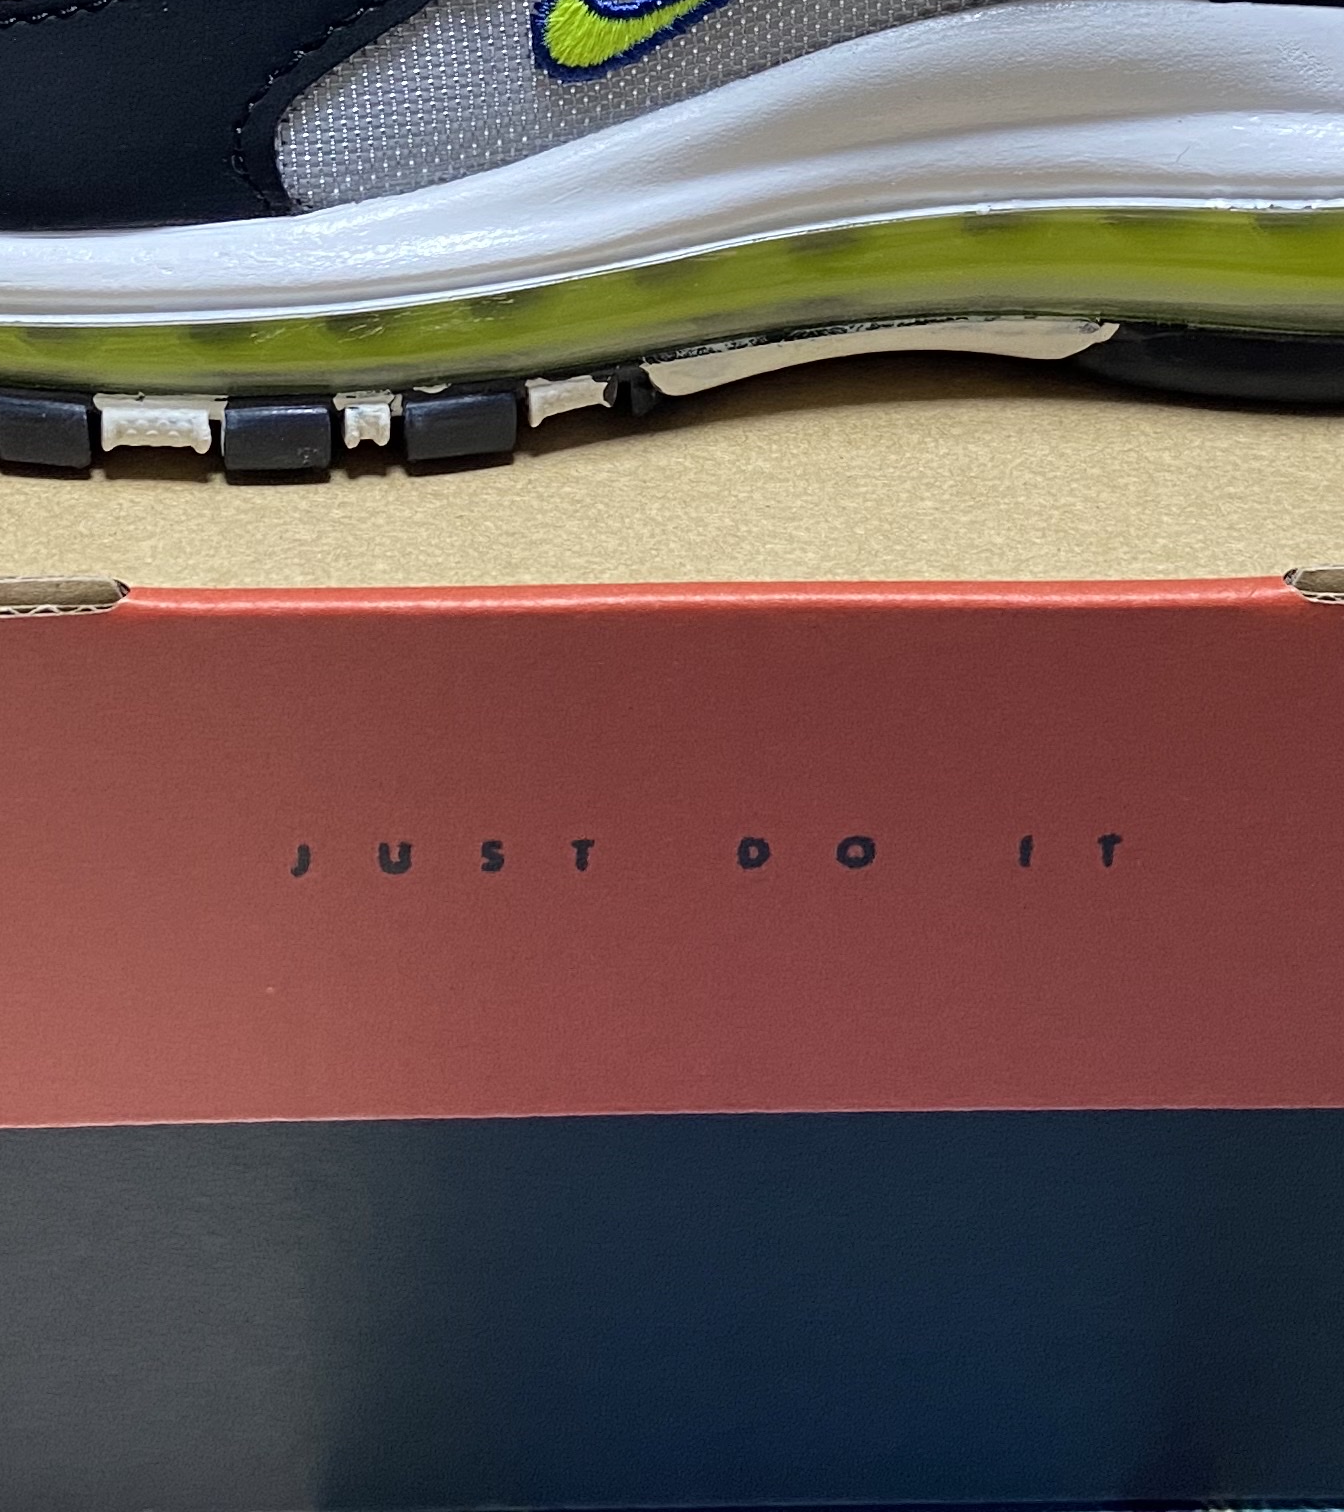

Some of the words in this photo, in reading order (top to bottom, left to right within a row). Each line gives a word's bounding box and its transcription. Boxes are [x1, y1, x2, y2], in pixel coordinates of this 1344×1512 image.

[289, 836, 596, 879] JUST
[734, 833, 879, 872] DO
[1016, 831, 1125, 870] IT
